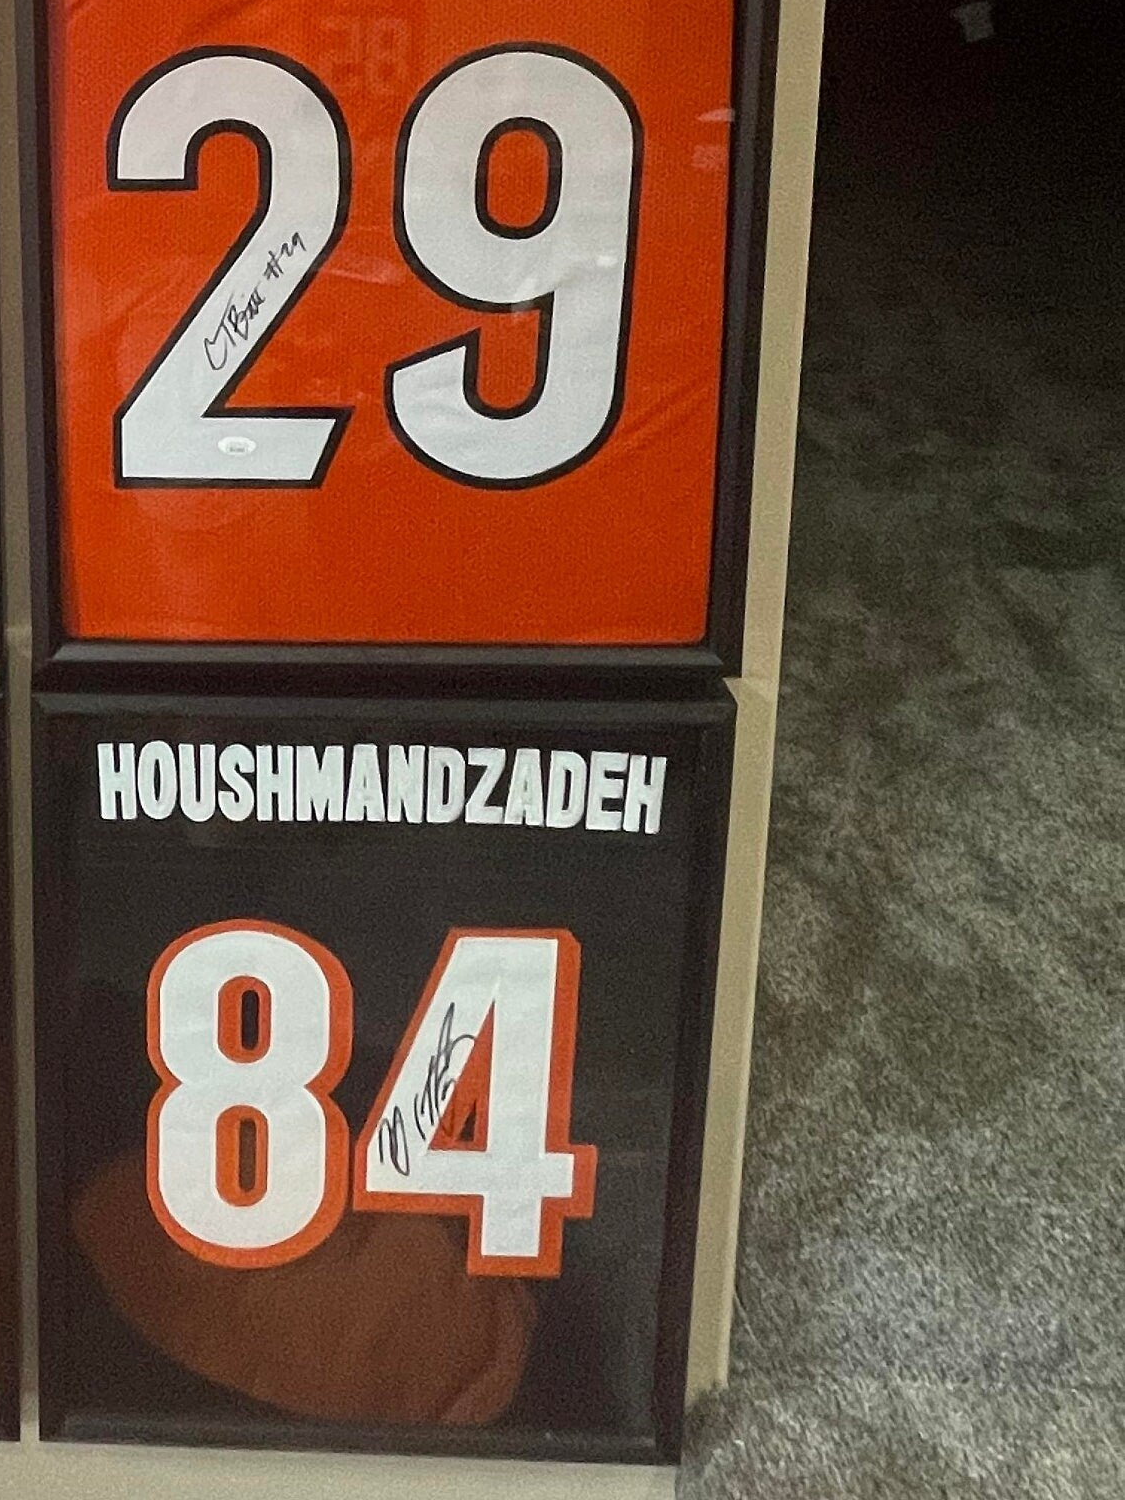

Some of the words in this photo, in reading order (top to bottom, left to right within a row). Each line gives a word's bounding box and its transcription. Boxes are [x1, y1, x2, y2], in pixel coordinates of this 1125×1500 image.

[107, 42, 645, 491] 29
[96, 741, 667, 834] HOUSHMANDZADEH
[146, 917, 598, 1279] 84
